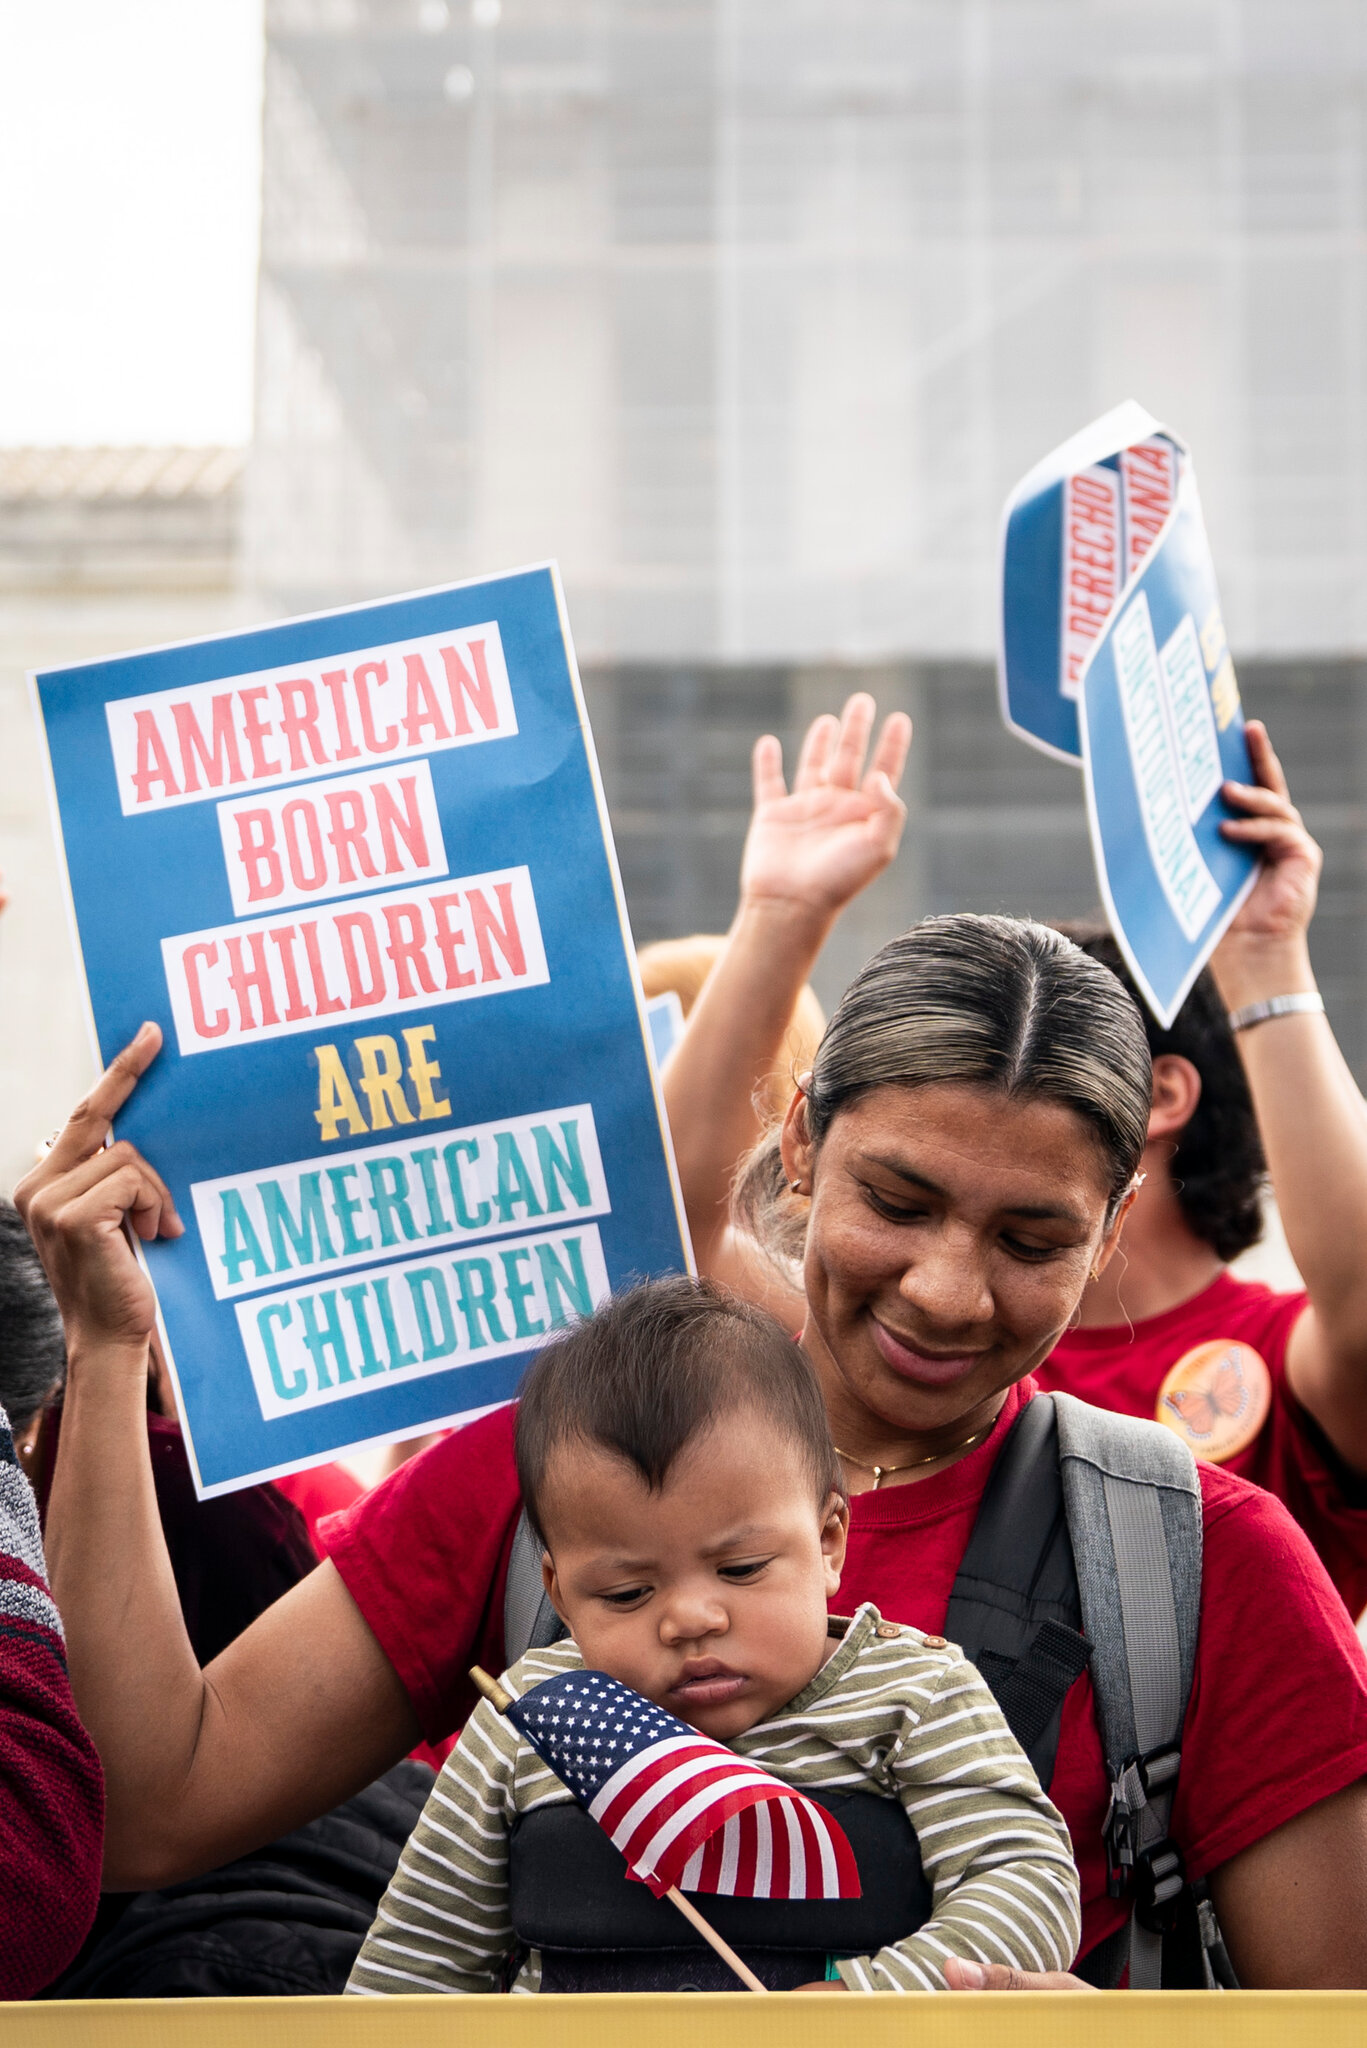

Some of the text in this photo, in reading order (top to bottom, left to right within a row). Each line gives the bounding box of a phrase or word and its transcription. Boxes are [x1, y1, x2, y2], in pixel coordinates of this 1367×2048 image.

[1068, 474, 1115, 638] DERECHO
[131, 639, 500, 803] AMERICAN
[233, 776, 432, 902] BORN
[181, 882, 529, 1039] CHILDREN
[313, 1024, 452, 1141] ARE
[219, 1120, 594, 1285] AMERICAN
[256, 1236, 594, 1401] CHILDREN
